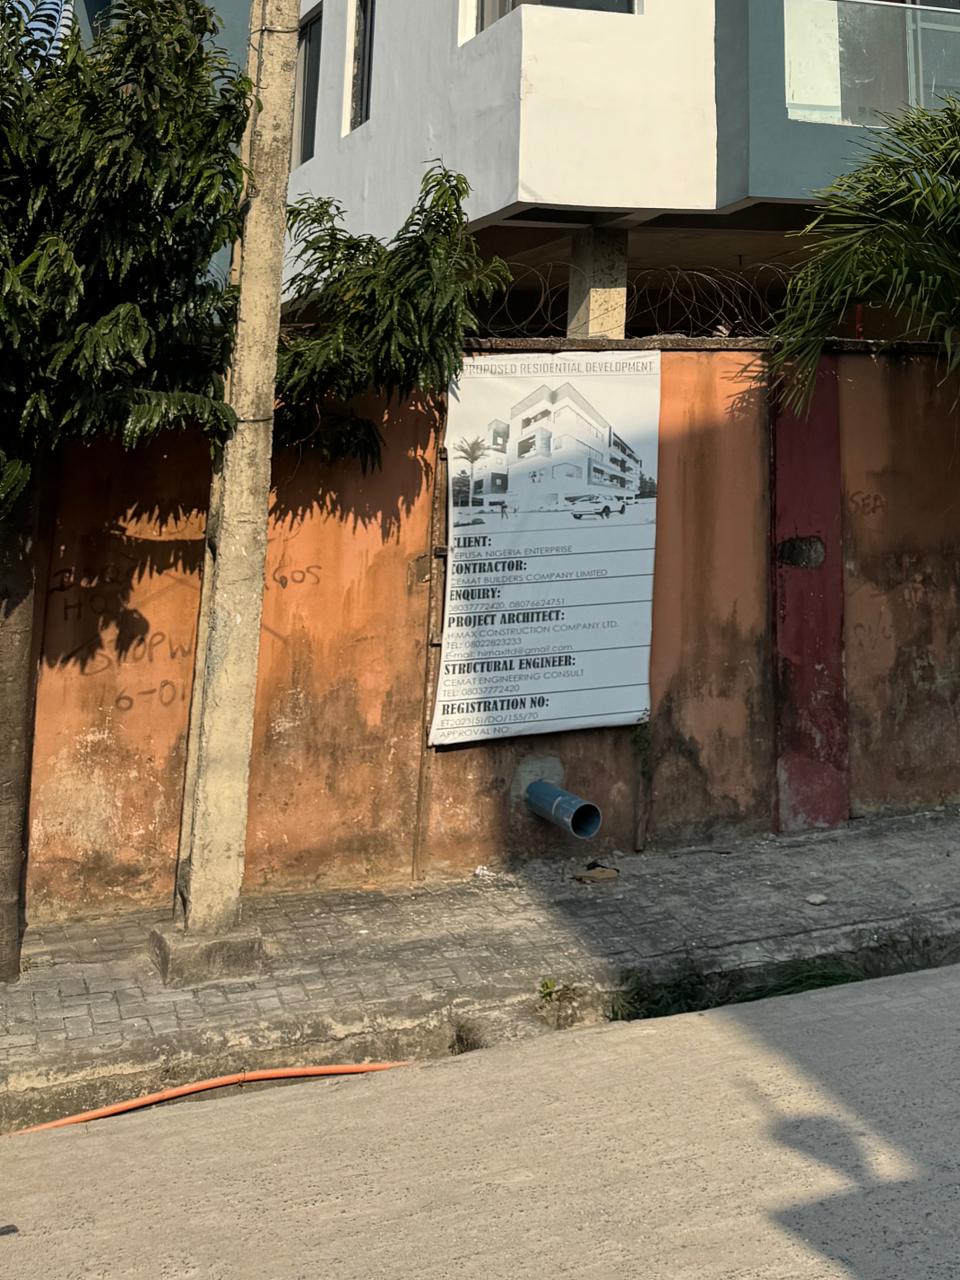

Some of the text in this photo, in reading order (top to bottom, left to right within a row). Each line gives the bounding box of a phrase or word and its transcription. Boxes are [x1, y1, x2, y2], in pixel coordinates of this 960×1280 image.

[520, 362, 583, 375] RESIDENTIAL
[585, 361, 655, 373] DEVELOPMENT
[485, 549, 521, 558] NIGERIA
[524, 545, 573, 555] ENTERPRISE
[483, 574, 523, 584] BUILDERS
[525, 571, 574, 581] COMPANY
[575, 569, 608, 578] LIMITED
[449, 587, 501, 601] ENQUIRY:
[447, 610, 565, 628] PROJECT ARCHITECT:
[479, 625, 550, 637] CONSTRUCTION
[552, 622, 600, 633] COMPANY
[444, 655, 576, 675] STRUCTURAL ENGINEER:
[443, 669, 584, 688] CEMAT ENGINEERING CONSULT
[441, 696, 549, 716] REGISTRATION NO:
[439, 727, 490, 739] APPROVAL
